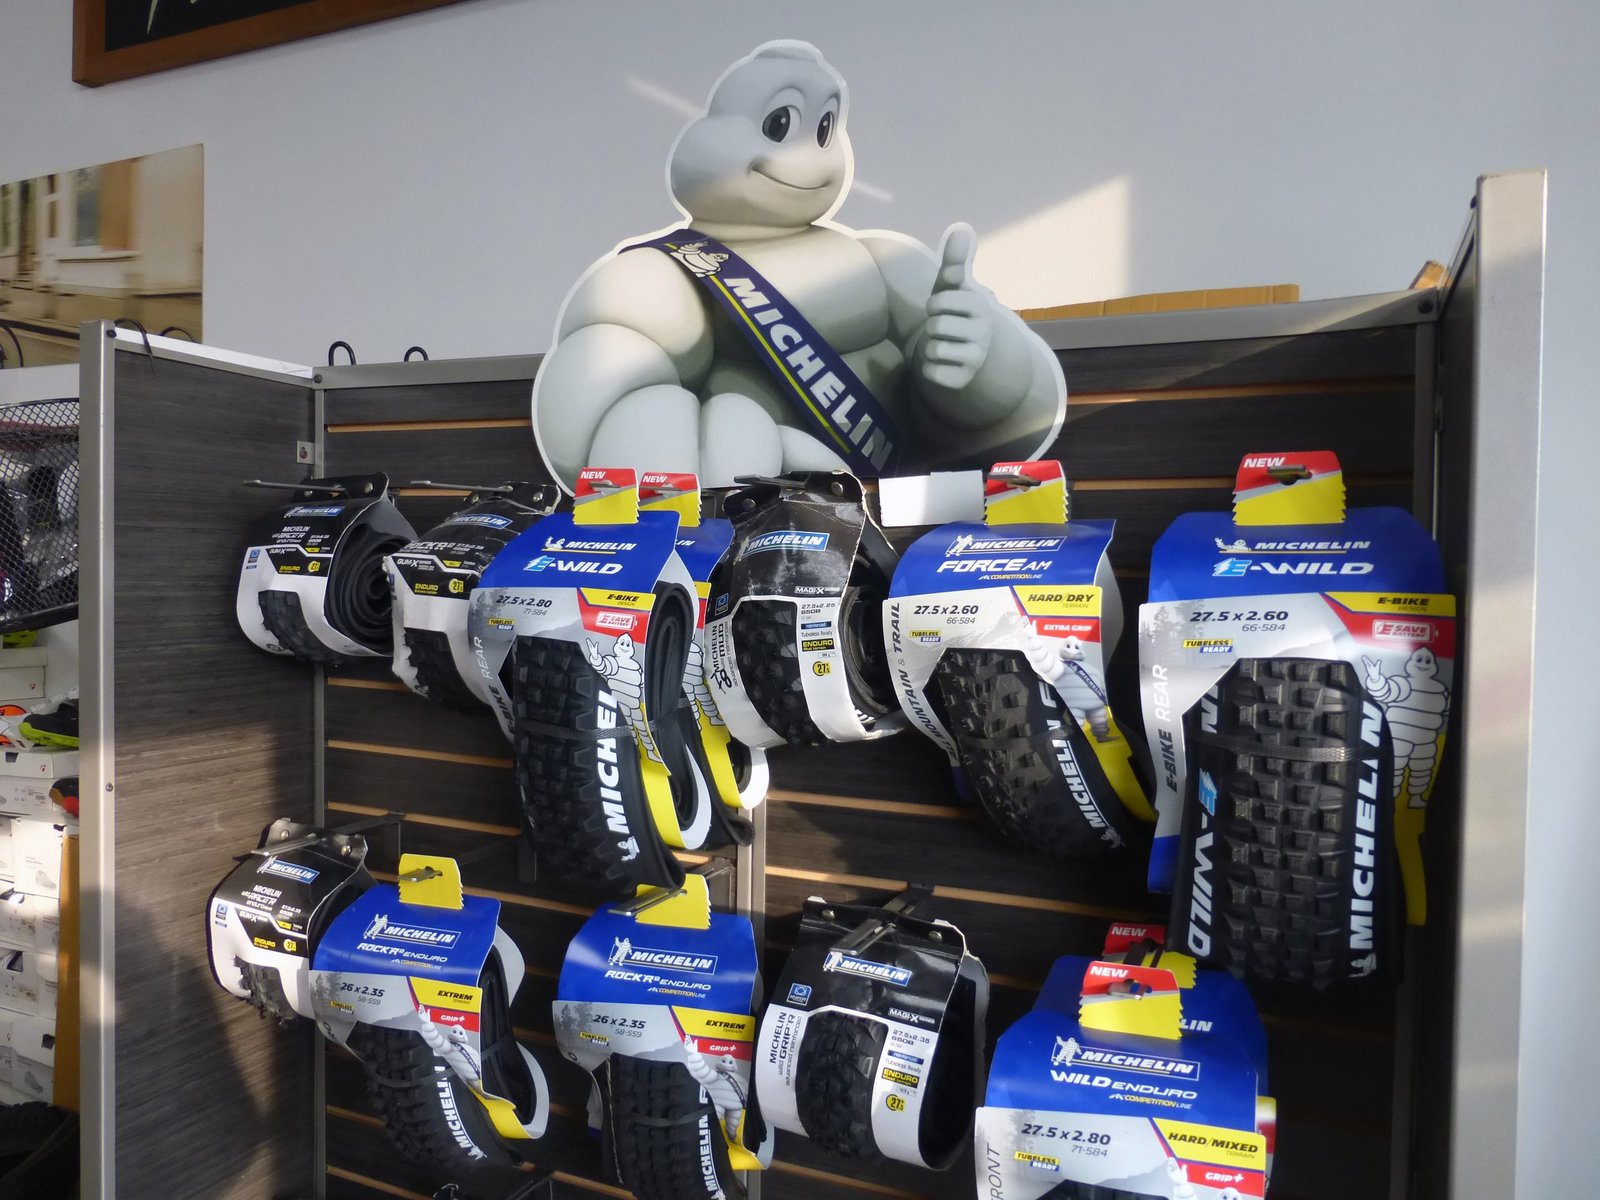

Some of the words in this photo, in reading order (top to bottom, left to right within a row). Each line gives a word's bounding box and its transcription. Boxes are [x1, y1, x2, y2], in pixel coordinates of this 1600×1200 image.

[724, 278, 893, 471] MICHELIN
[1244, 457, 1285, 468] NEW
[581, 471, 606, 480] NEW
[992, 465, 1022, 474] NEW
[642, 475, 667, 484] NEW
[566, 541, 637, 551] MICHELIN
[747, 534, 824, 551] MICHELIN
[970, 539, 1060, 549] MICHELIN
[1255, 541, 1371, 550] MICHELIN
[524, 556, 623, 574] E-WILD
[936, 558, 1027, 573] FORCE
[1022, 560, 1053, 571] AM
[1212, 558, 1374, 576] E-WILD
[496, 595, 520, 605] 27.5
[526, 598, 553, 608] 2.80
[607, 594, 640, 602] E-BIKE
[1377, 597, 1430, 606] E-BIKE
[524, 608, 548, 616] 71-584
[914, 605, 940, 614] 27.5
[950, 605, 979, 614] 2.60
[1190, 611, 1230, 622] 27.5
[1245, 611, 1289, 621] 2.60
[891, 602, 903, 653] TRAIL
[1242, 624, 1286, 632] 66-584
[1394, 625, 1428, 633] SAVE
[712, 625, 720, 672] MICHELIN
[474, 636, 493, 680] REAR
[1152, 664, 1172, 722] REAR
[898, 669, 946, 742] MOUNTAIN
[1162, 728, 1178, 793] E-BIKE
[270, 863, 315, 879] MICHELIN
[253, 884, 282, 898] MICHELIN
[384, 926, 456, 943] MICHELIN
[1111, 927, 1147, 936] NEW
[403, 951, 448, 963] ENDURO
[631, 951, 713, 969] MICHELIN
[842, 960, 908, 981] MICHELIN
[1090, 966, 1128, 978] NEW
[341, 982, 354, 991] 26
[361, 986, 385, 997] 2.35
[659, 979, 712, 990] ENDURO
[437, 990, 473, 1000] EXTREM
[593, 1014, 610, 1024] 26
[618, 1018, 646, 1029] 2.35
[705, 1020, 746, 1030] EXTREM
[581, 1032, 608, 1041] TUBELESS
[614, 1028, 643, 1038] 58-559
[770, 1012, 787, 1064] MICHELIN
[1081, 1050, 1195, 1075] MICHELIN
[883, 1068, 919, 1084] ENDURO
[1050, 1070, 1112, 1088] WILD
[1111, 1082, 1198, 1100] ENDURO
[1021, 1123, 1058, 1137] 27.5
[1071, 1130, 1111, 1145] 2.80
[699, 1114, 719, 1191] MICHELIN
[1071, 1145, 1108, 1157] 71-584
[1226, 1150, 1255, 1159] TERRAIN
[1017, 1153, 1056, 1164] TUBELESS
[1032, 1161, 1057, 1170] READY
